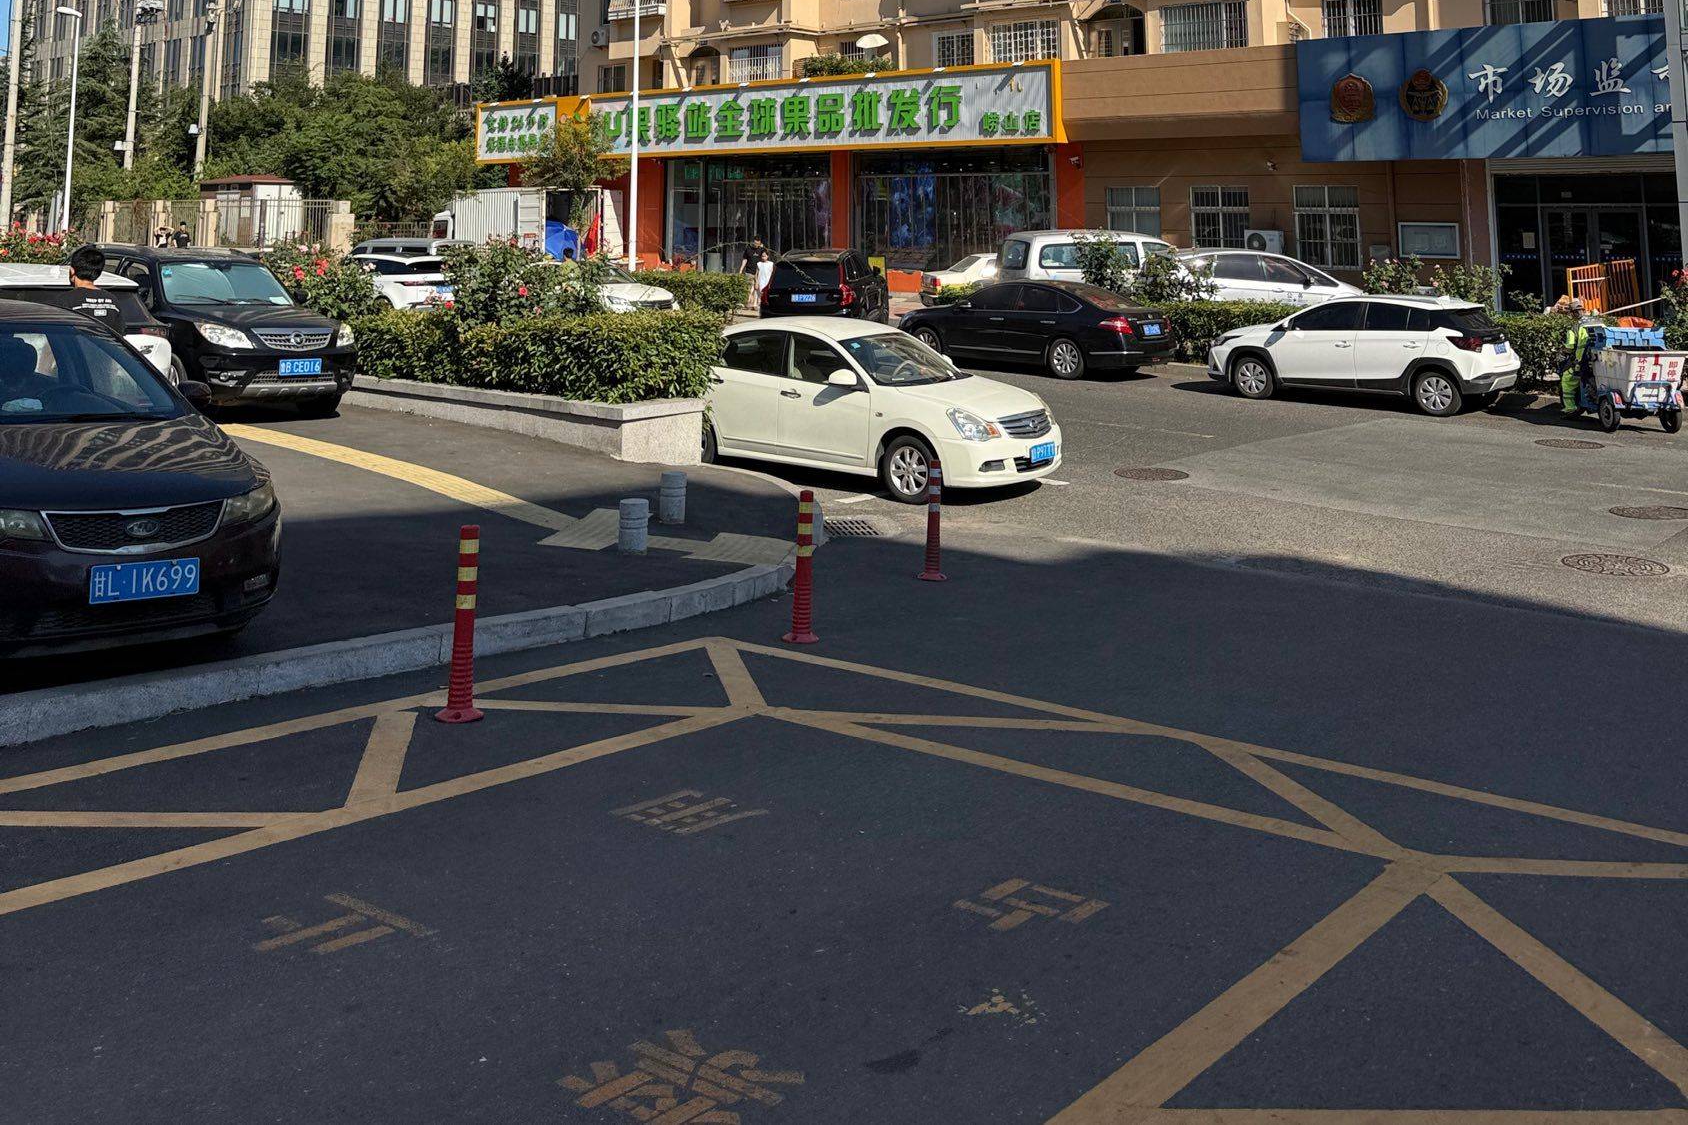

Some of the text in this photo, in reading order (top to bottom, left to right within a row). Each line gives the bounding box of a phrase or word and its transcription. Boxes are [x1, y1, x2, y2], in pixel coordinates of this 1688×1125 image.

[1468, 57, 1669, 104] 市场监
[603, 85, 962, 141] U果驿站全球果品批发行
[982, 110, 1041, 132] 崂山店
[1476, 106, 1533, 120] Market
[1541, 103, 1644, 119] Supervision
